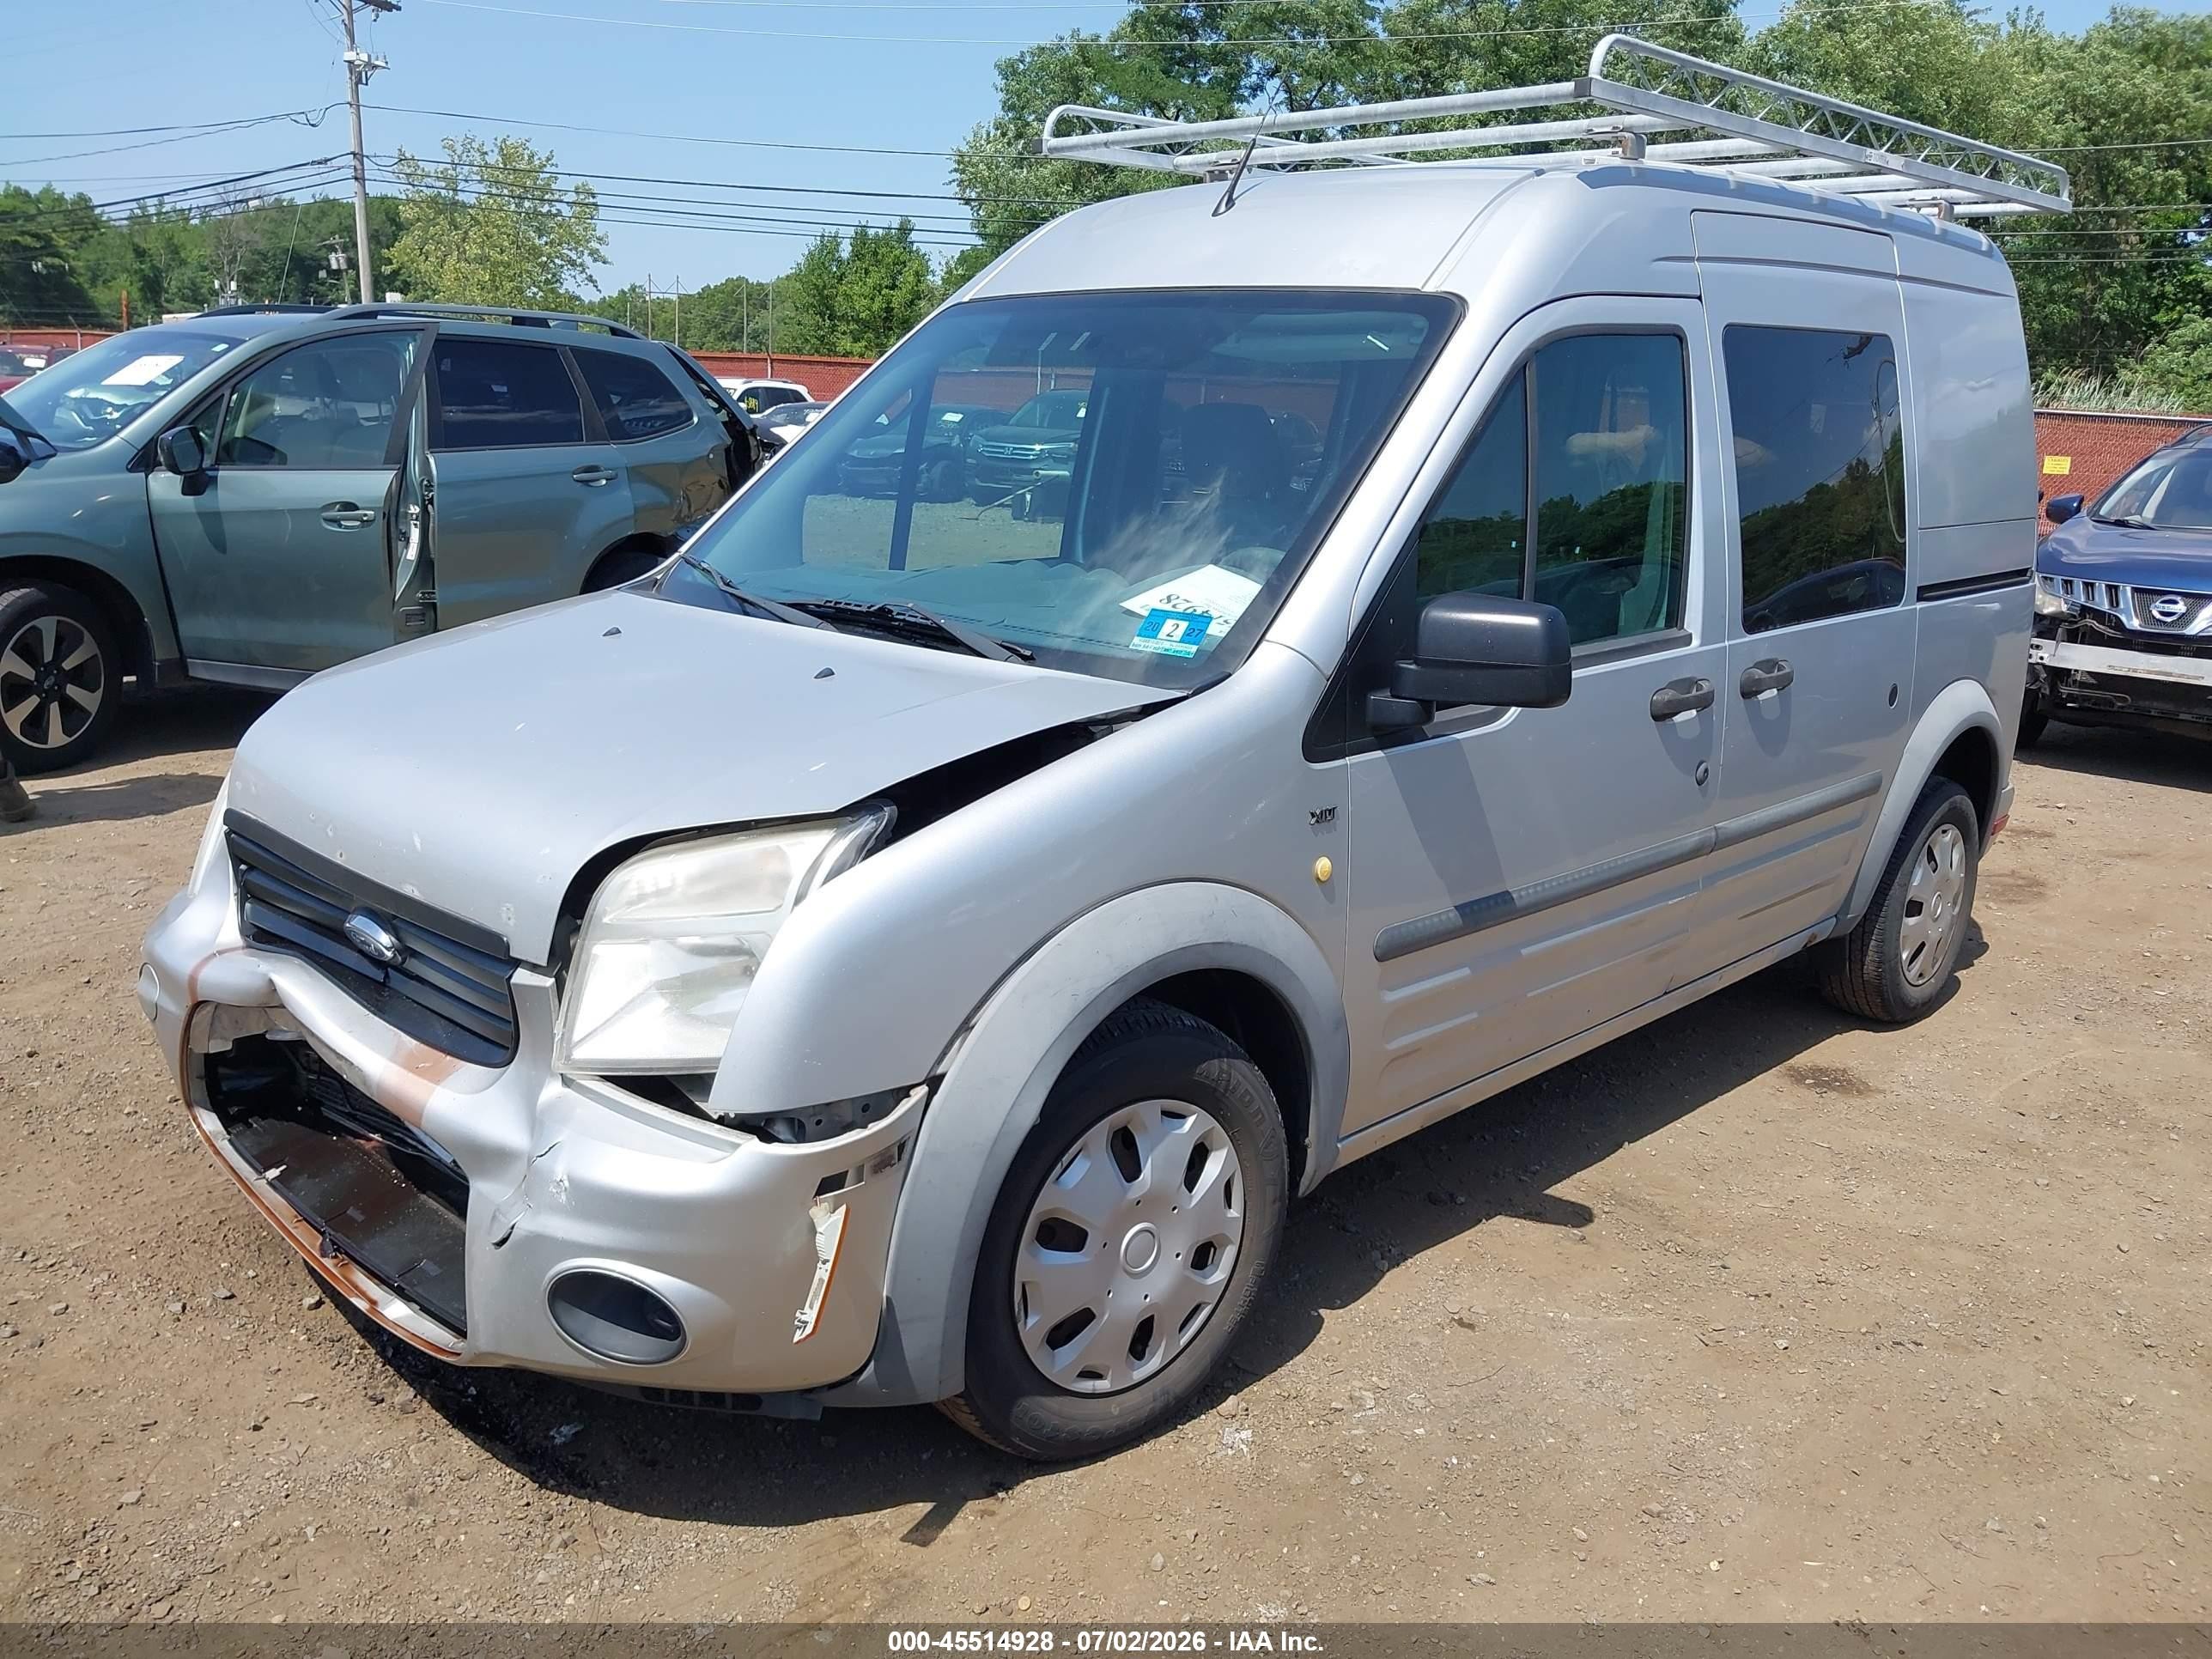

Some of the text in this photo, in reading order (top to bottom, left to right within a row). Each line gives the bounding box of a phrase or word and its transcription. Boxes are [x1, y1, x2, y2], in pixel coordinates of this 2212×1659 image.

[1146, 621, 1204, 638] 20 2 27
